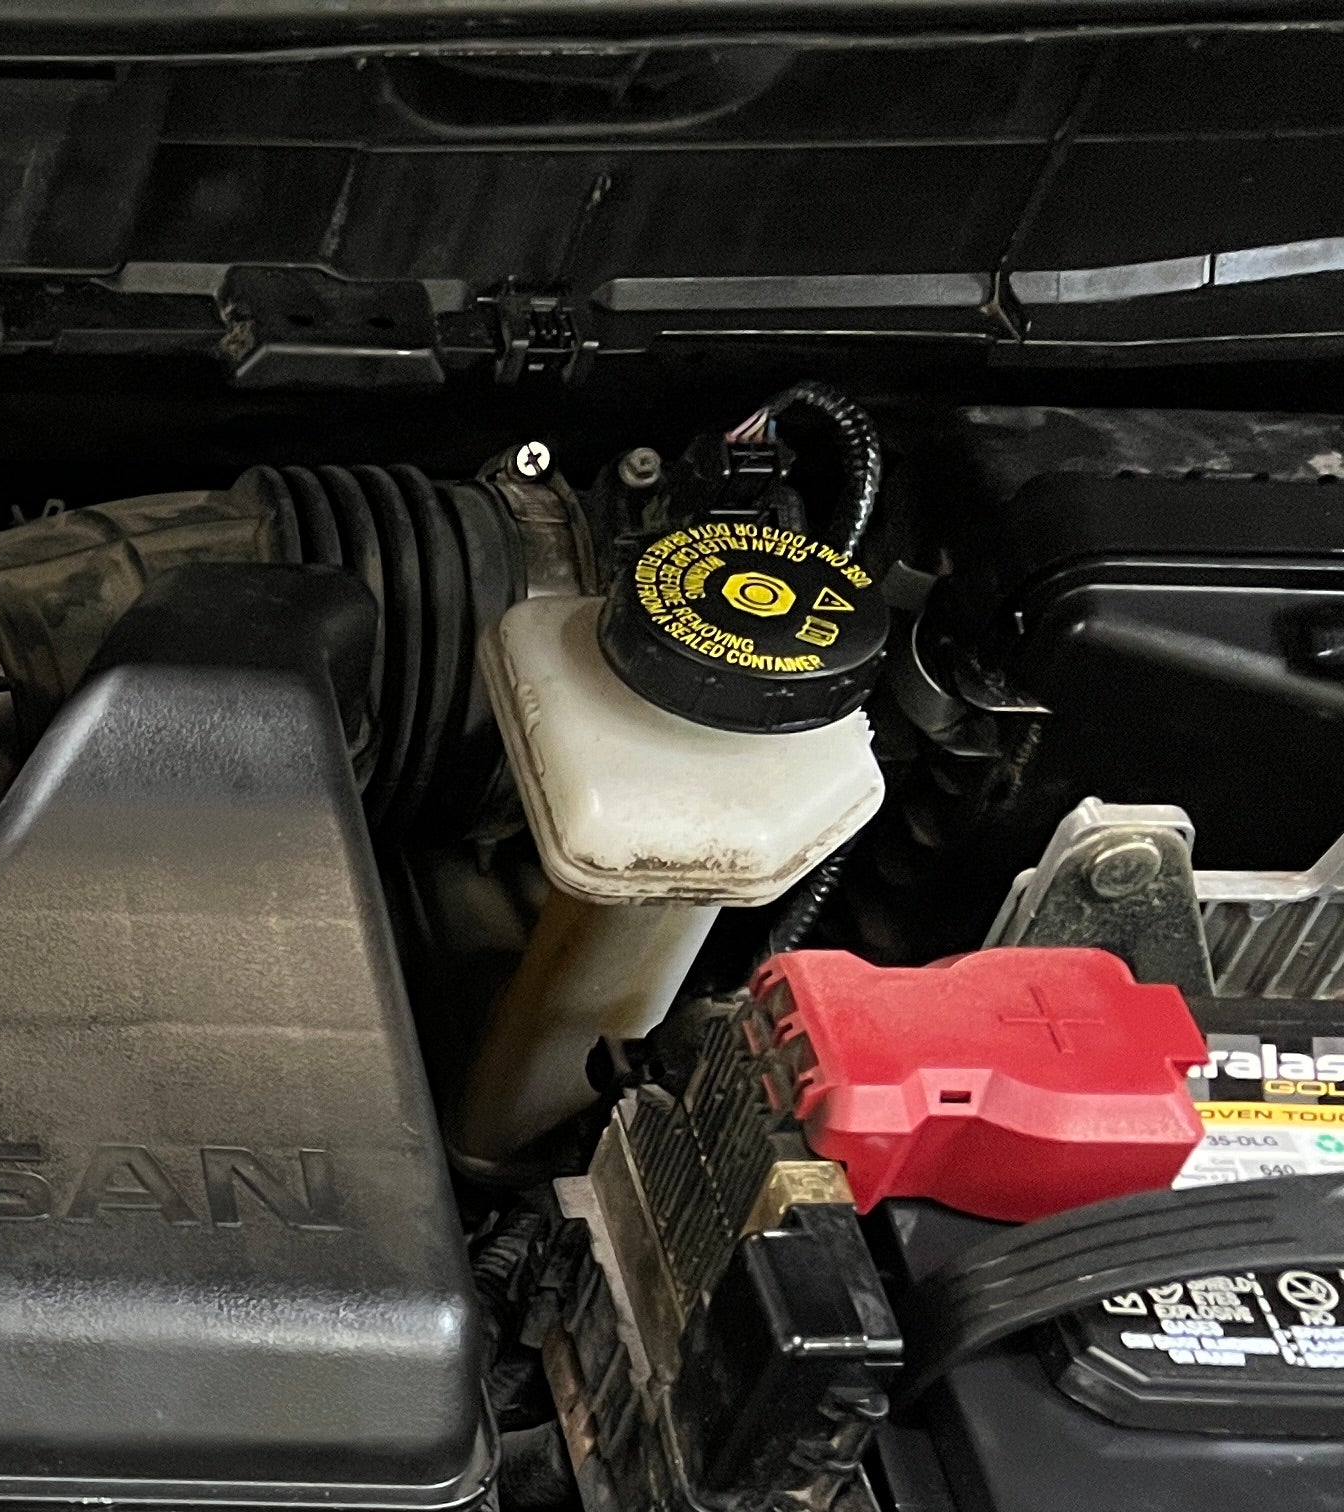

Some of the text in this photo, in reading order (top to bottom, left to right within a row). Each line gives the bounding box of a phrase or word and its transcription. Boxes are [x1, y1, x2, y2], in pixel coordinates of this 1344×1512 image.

[688, 522, 731, 540] DOT4
[733, 522, 758, 538] OR
[762, 525, 807, 548] DOT3
[805, 541, 850, 569] ONLY
[683, 555, 727, 600] WARNING
[658, 536, 808, 653] CLEAN FILLER CAP BEFORE REMOVING
[651, 614, 667, 626] A
[664, 621, 725, 658] SEALED
[726, 651, 825, 672] CONTAINER
[1206, 1135, 1279, 1148] 35-DLG
